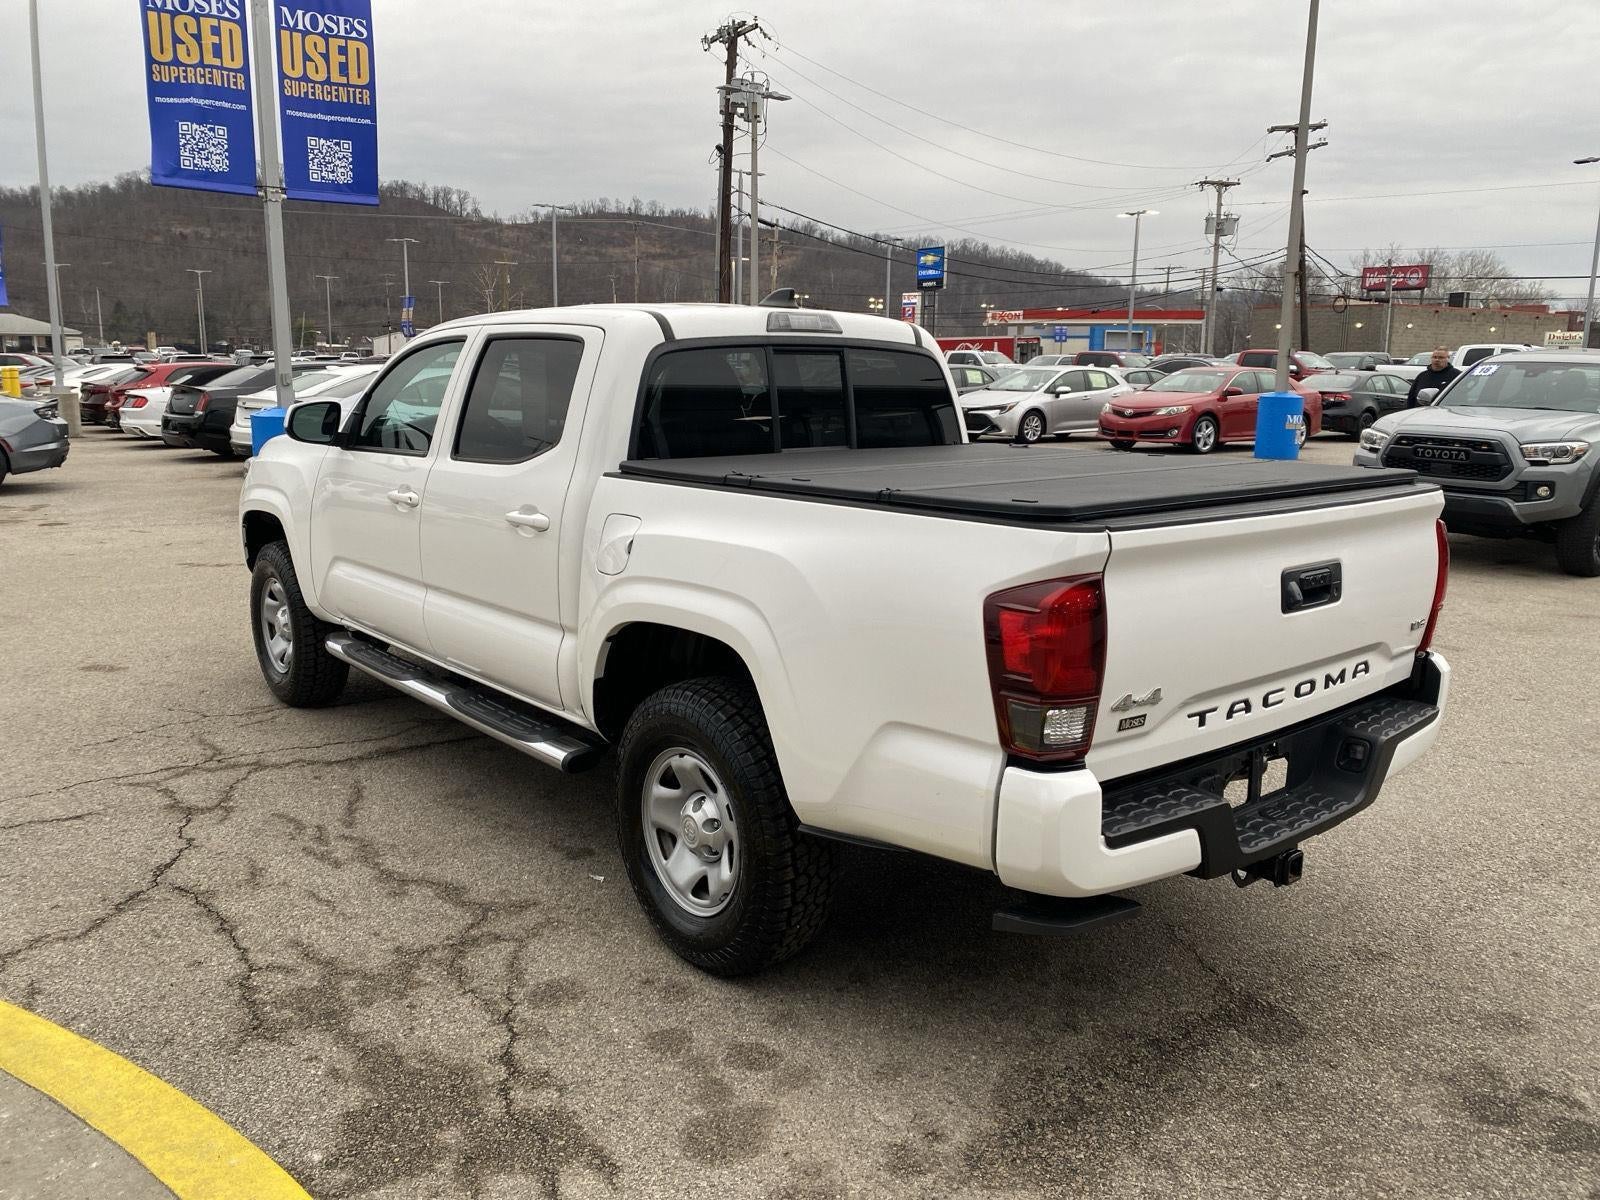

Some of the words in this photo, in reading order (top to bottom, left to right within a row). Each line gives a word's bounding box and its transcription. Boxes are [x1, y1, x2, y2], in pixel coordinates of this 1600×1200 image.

[280, 5, 368, 39] MOSES
[147, 10, 244, 69] USED
[280, 29, 370, 86] USED
[151, 63, 246, 91] SUPERCENTER
[284, 79, 371, 105] SUPERCENTER
[154, 96, 247, 111] mosesusedsupercenter.com
[286, 109, 373, 125] mosesusedsupercenter.com
[1365, 268, 1405, 287] Wendy's
[991, 311, 1021, 322] EXXON
[1548, 333, 1583, 341] Dwight's
[1416, 447, 1467, 460] TOYOTA
[1187, 660, 1370, 728] TACOMA
[1119, 715, 1146, 731] MOSES
